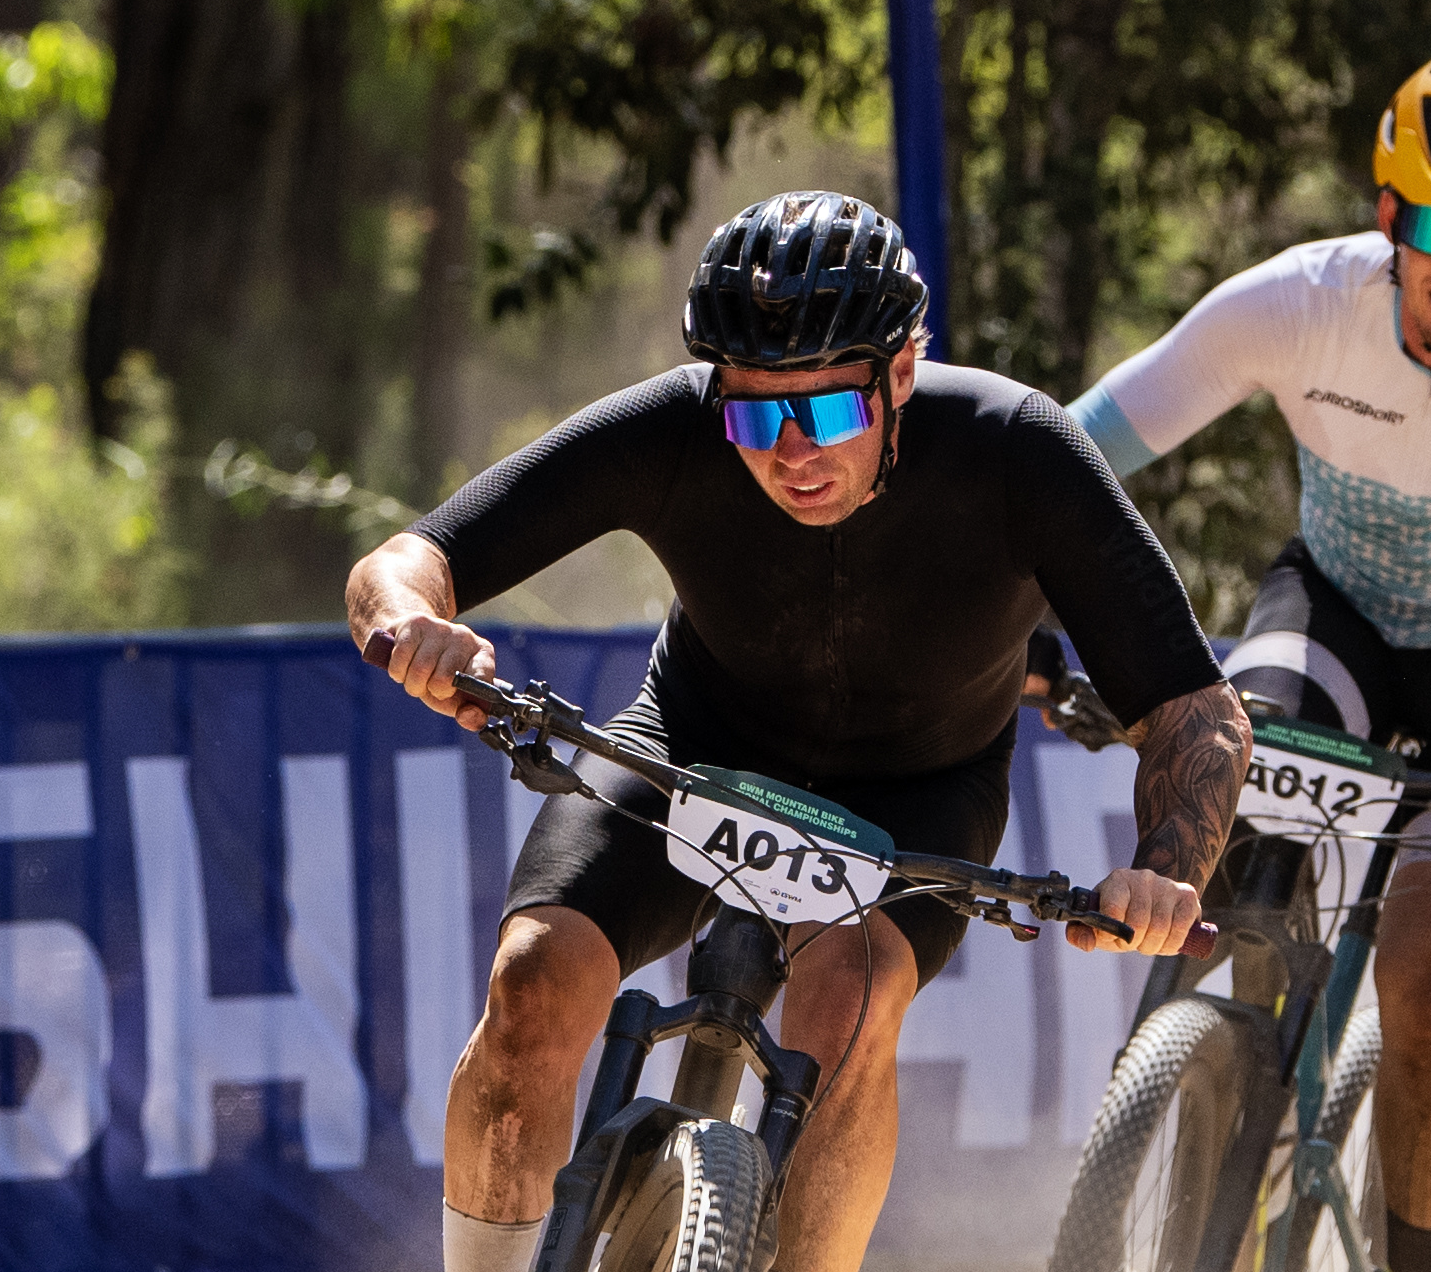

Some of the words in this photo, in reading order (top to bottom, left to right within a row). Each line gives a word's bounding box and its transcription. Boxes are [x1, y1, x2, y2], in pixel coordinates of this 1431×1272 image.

[739, 781, 764, 797] GWM
[766, 790, 819, 816] MOUNTAIN
[821, 810, 846, 826] BIKE
[1244, 763, 1364, 817] A012
[773, 802, 858, 840] CHAMPIONSHIPS
[702, 818, 849, 895] A013
